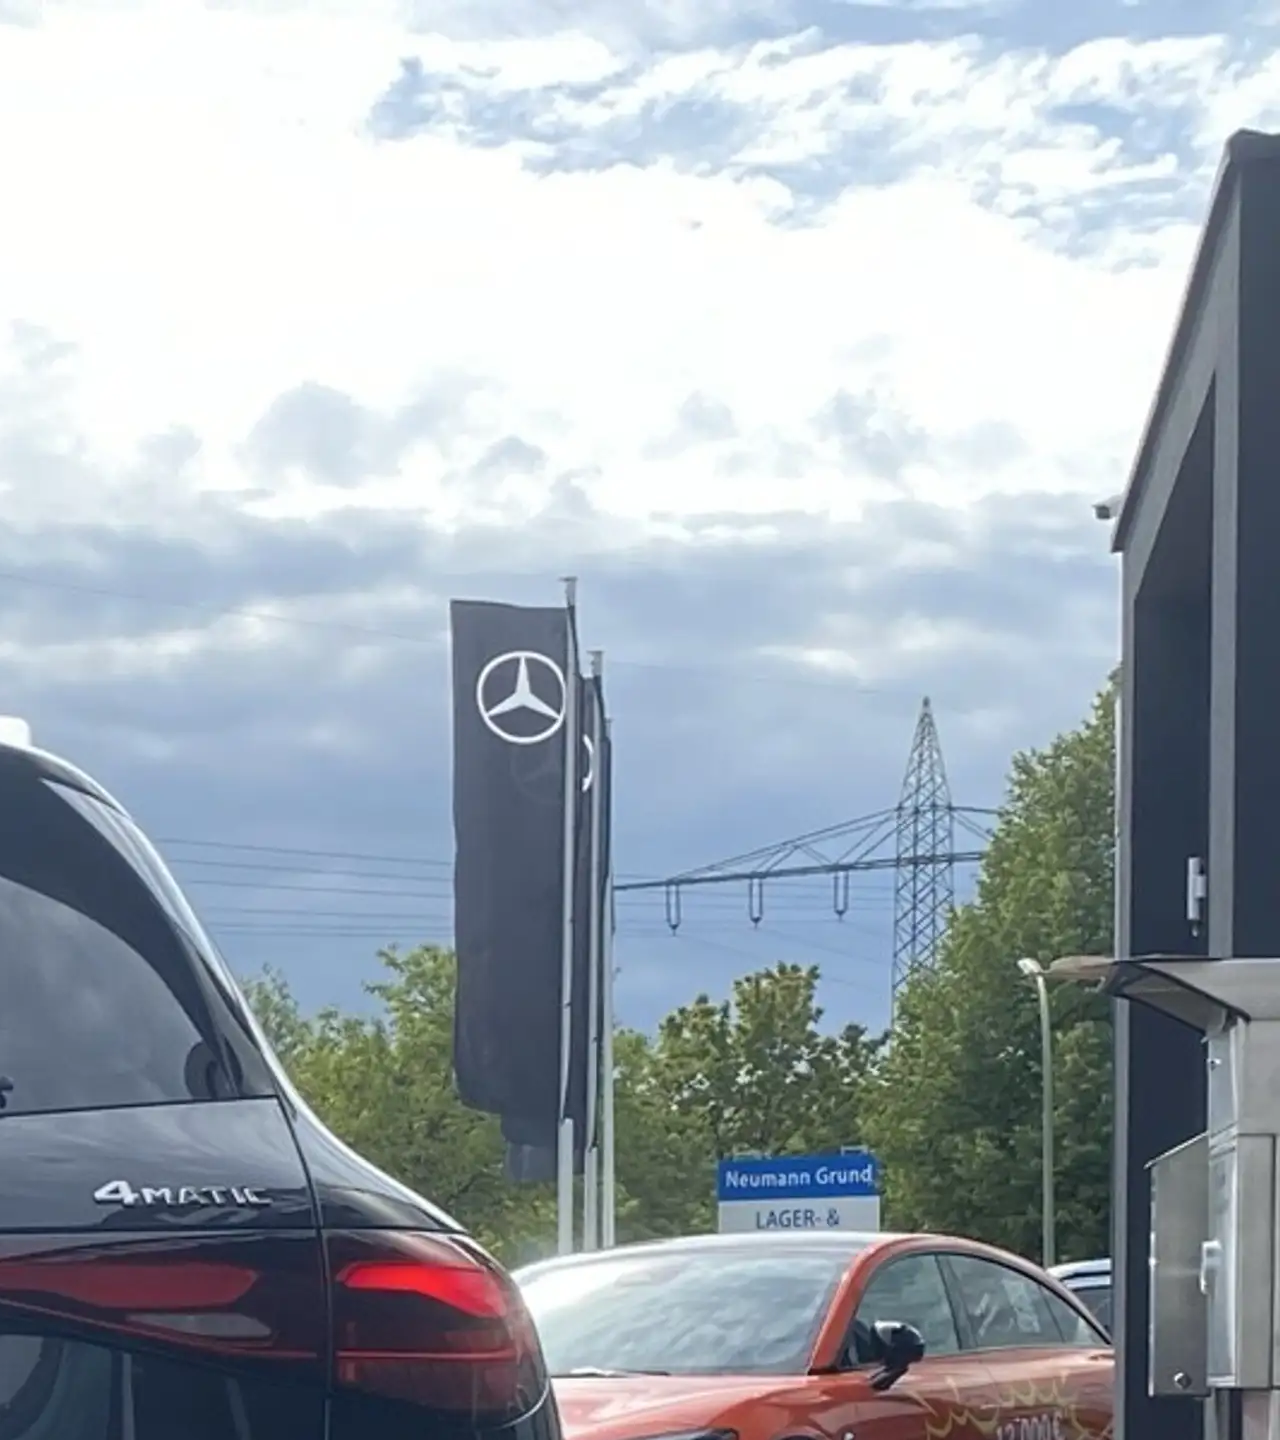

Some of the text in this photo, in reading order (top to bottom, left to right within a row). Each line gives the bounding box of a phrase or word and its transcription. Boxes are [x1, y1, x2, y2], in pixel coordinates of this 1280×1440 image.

[725, 1164, 873, 1188] Neumann Grund
[93, 1180, 273, 1205] 4MATIC
[756, 1208, 840, 1229] LAGER- &
